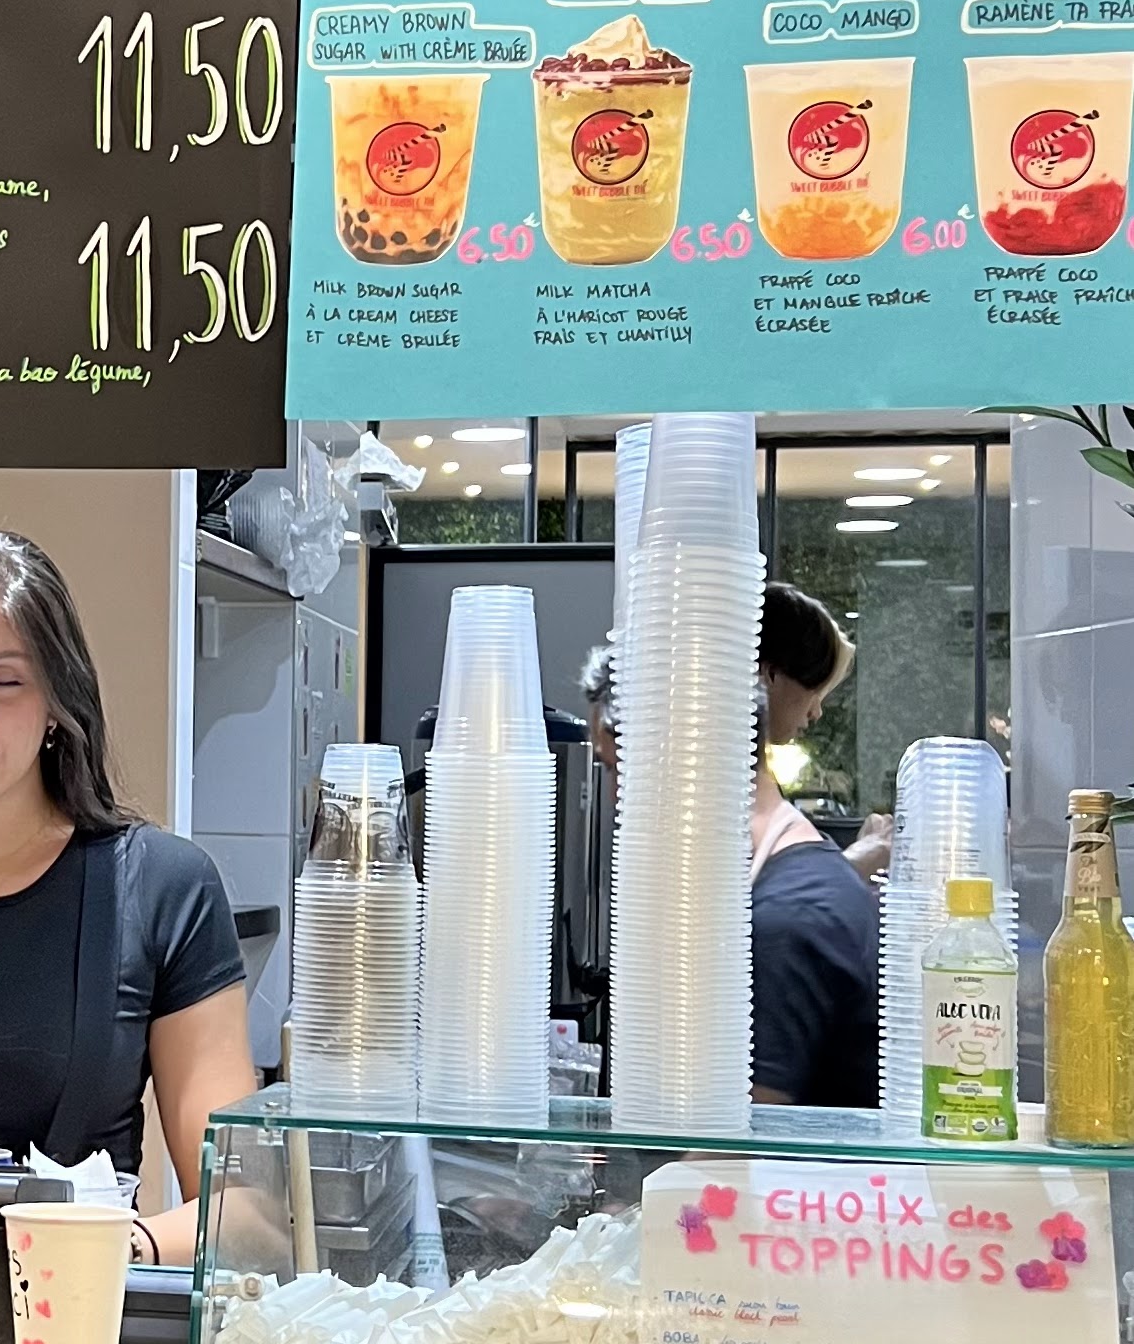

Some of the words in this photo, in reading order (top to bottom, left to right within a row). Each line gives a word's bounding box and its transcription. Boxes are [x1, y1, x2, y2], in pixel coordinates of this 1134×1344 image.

[1064, 3, 1089, 21] TA
[317, 14, 390, 36] CREAMY
[402, 12, 466, 33] BROWN
[773, 14, 822, 33] COCO
[841, 8, 911, 29] MANGO
[314, 43, 365, 61] SUGAR
[77, 12, 284, 162] 11,50
[825, 273, 860, 286] COCO
[1059, 267, 1097, 283] COCO
[77, 215, 276, 365] 11,50
[412, 283, 462, 297] SUGAR
[587, 282, 651, 297] MATCHA
[974, 288, 994, 303] ET
[754, 296, 776, 311] ET
[784, 294, 861, 310] MANGUE
[324, 309, 342, 323] LA
[348, 308, 398, 323] CREAM
[409, 309, 458, 323] CHEESE
[636, 306, 688, 321] ROUGE
[306, 331, 324, 345] ET
[587, 330, 607, 344] ET
[20, 360, 58, 382] bao
[66, 354, 151, 390] légume,
[947, 1204, 1012, 1232] des
